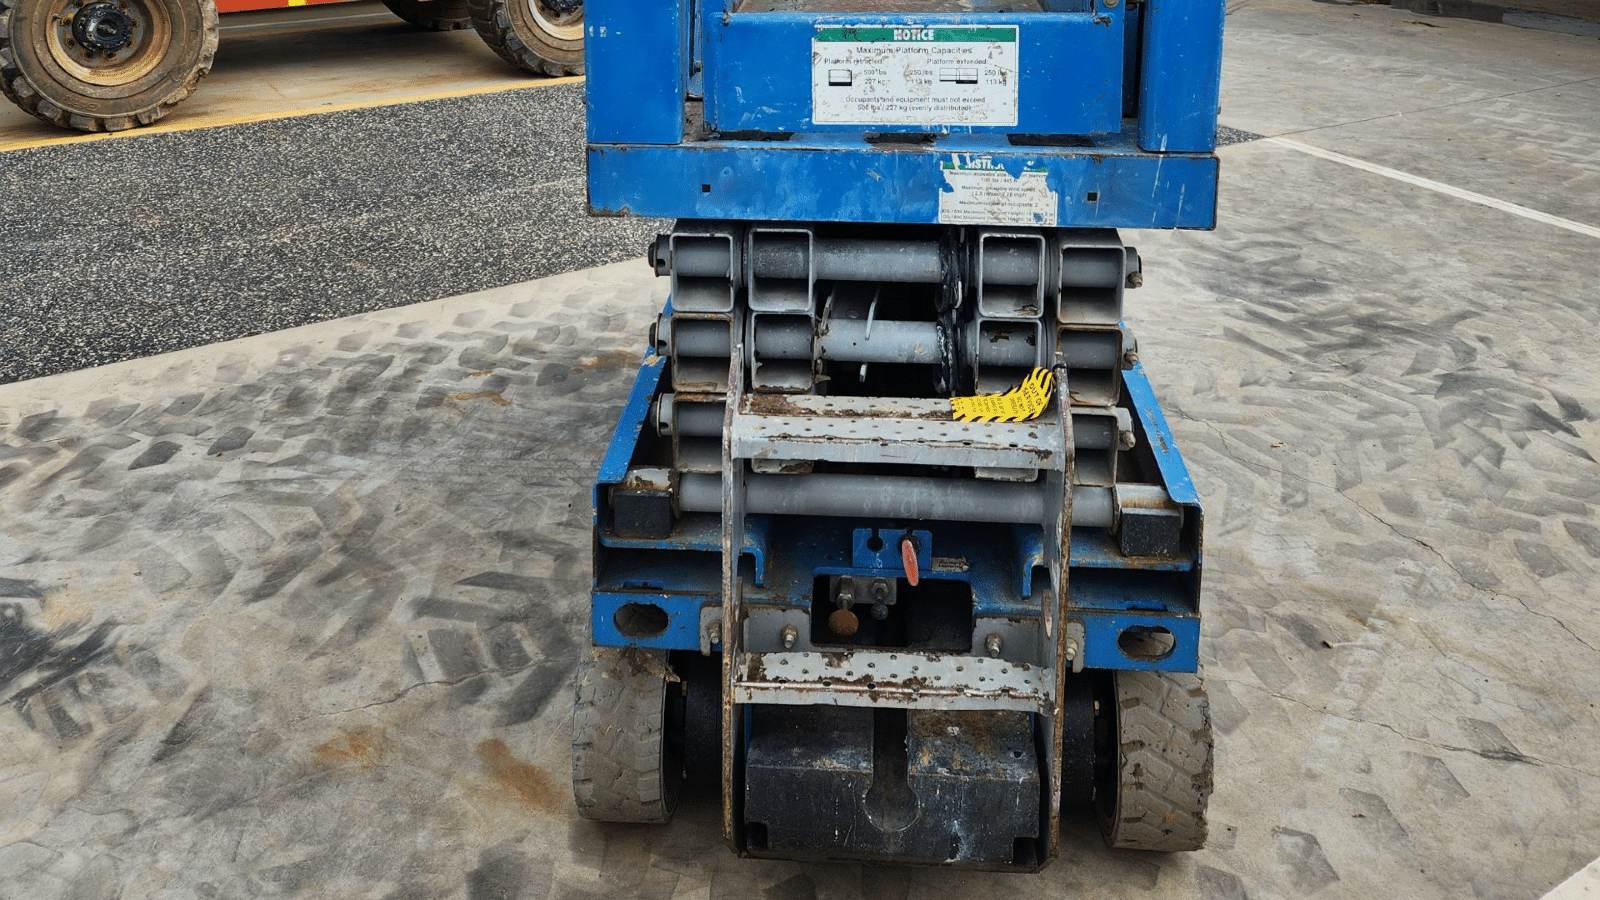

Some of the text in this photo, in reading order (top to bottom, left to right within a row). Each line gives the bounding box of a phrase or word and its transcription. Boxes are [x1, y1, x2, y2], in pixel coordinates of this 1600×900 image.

[893, 29, 935, 41] NOTICE
[856, 46, 893, 54] Maximum
[931, 47, 973, 55] Capacities
[1022, 387, 1038, 414] SERVICE
[1029, 382, 1044, 407] OUT OF
